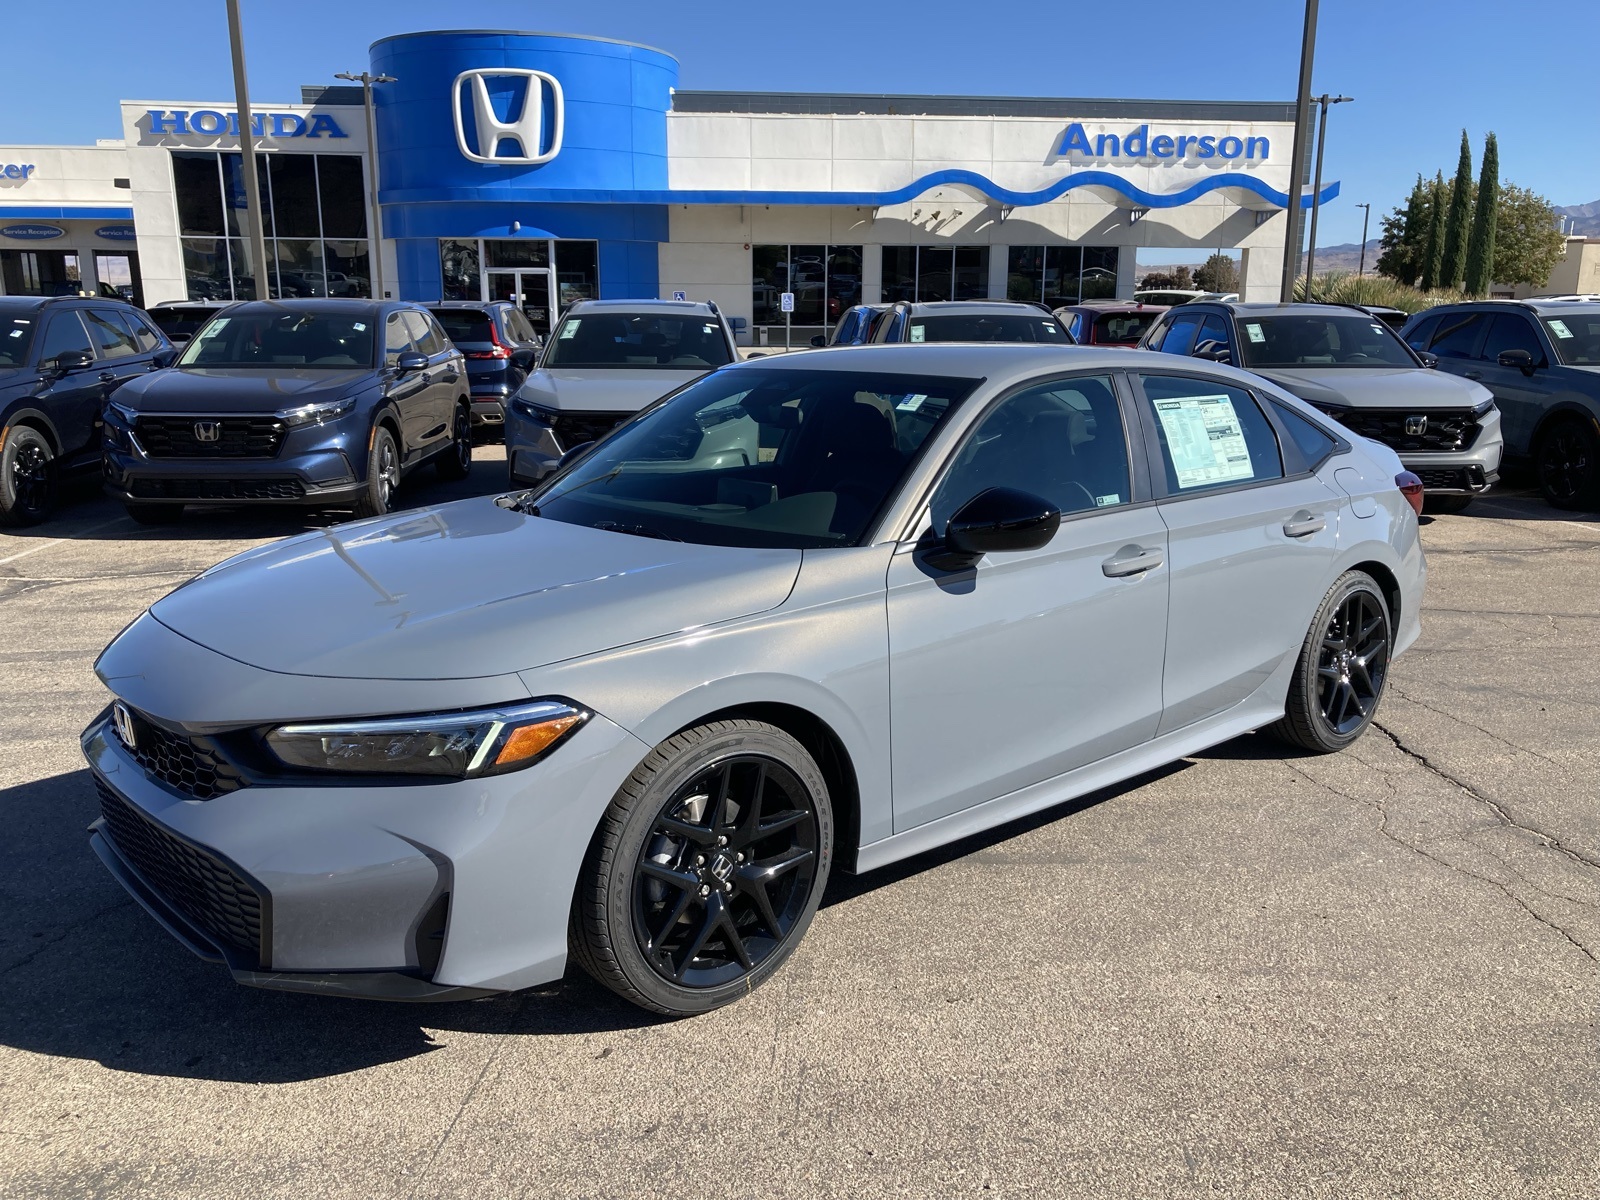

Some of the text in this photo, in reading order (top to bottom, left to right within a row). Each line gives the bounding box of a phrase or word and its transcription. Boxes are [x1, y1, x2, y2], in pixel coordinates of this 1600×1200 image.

[147, 110, 349, 138] HONDA
[1058, 123, 1270, 159] Anderson
[3, 228, 61, 236] Service Reception
[806, 772, 827, 816] EAGLE
[615, 871, 647, 981] GOODYEAR
